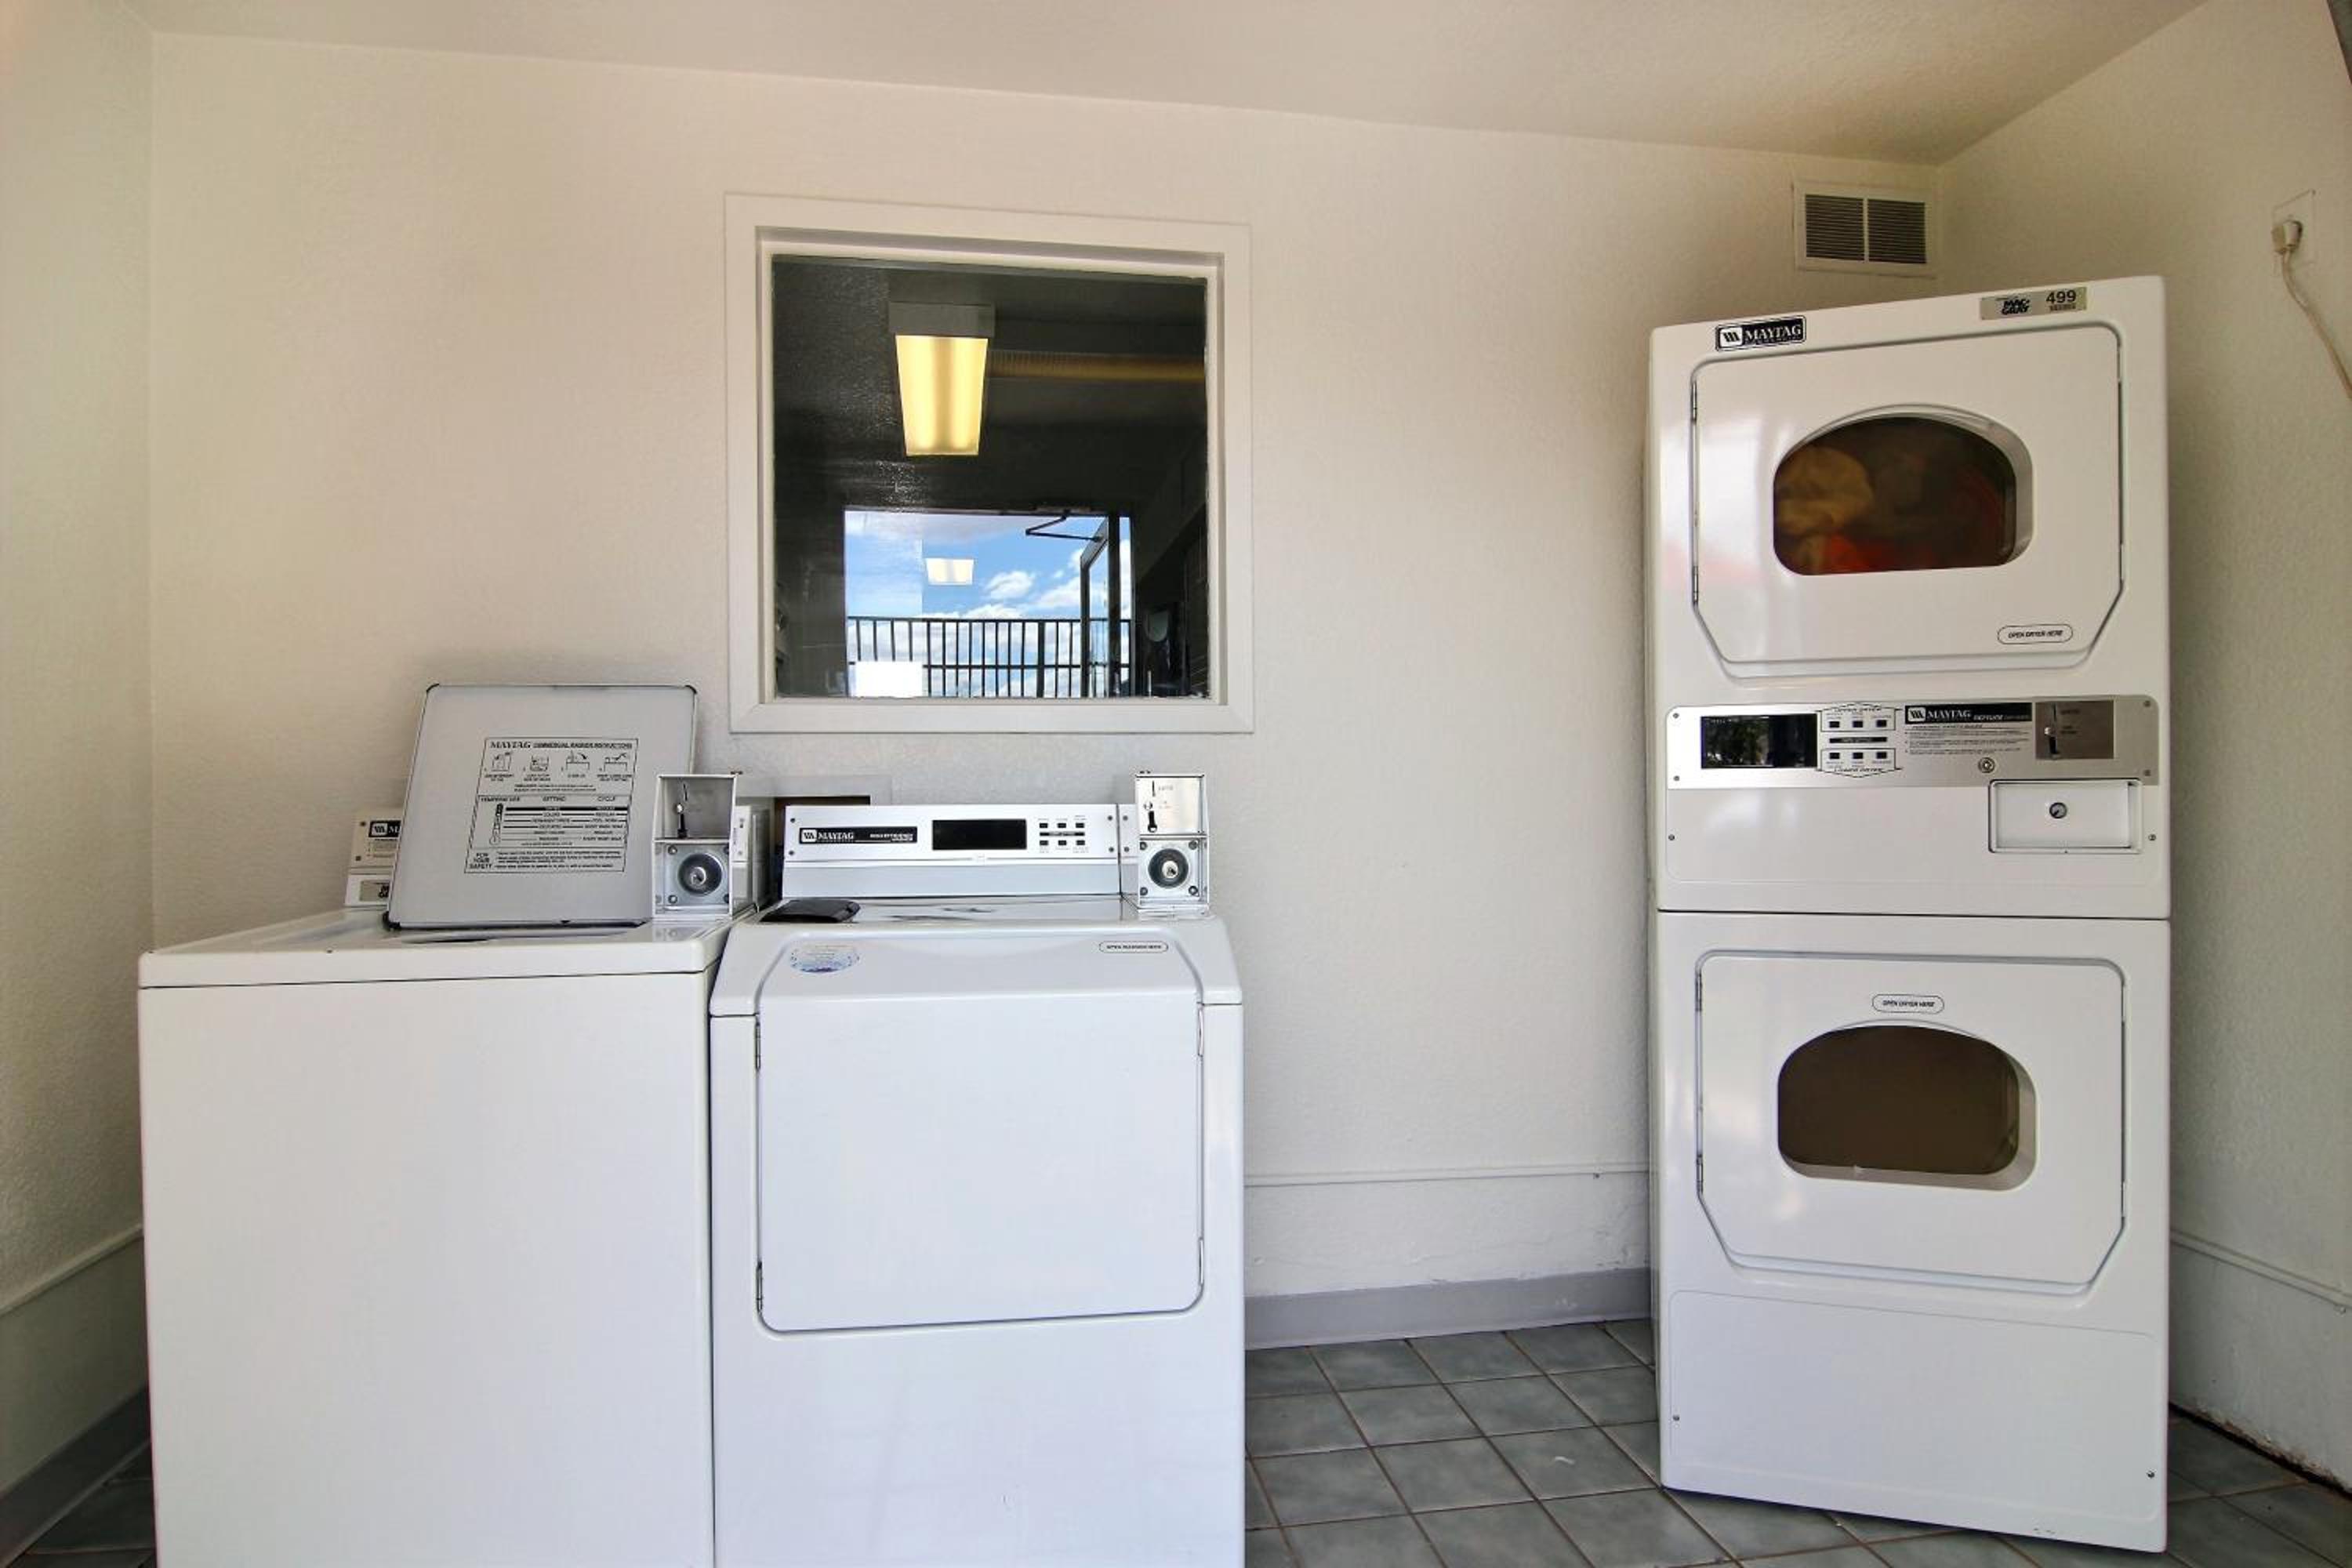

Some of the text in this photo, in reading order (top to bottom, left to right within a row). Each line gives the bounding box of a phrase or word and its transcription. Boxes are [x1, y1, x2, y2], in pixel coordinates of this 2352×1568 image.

[2045, 289, 2077, 303] 499
[1744, 324, 1802, 341] MAYTAG
[1926, 710, 1972, 720] MAYTAG
